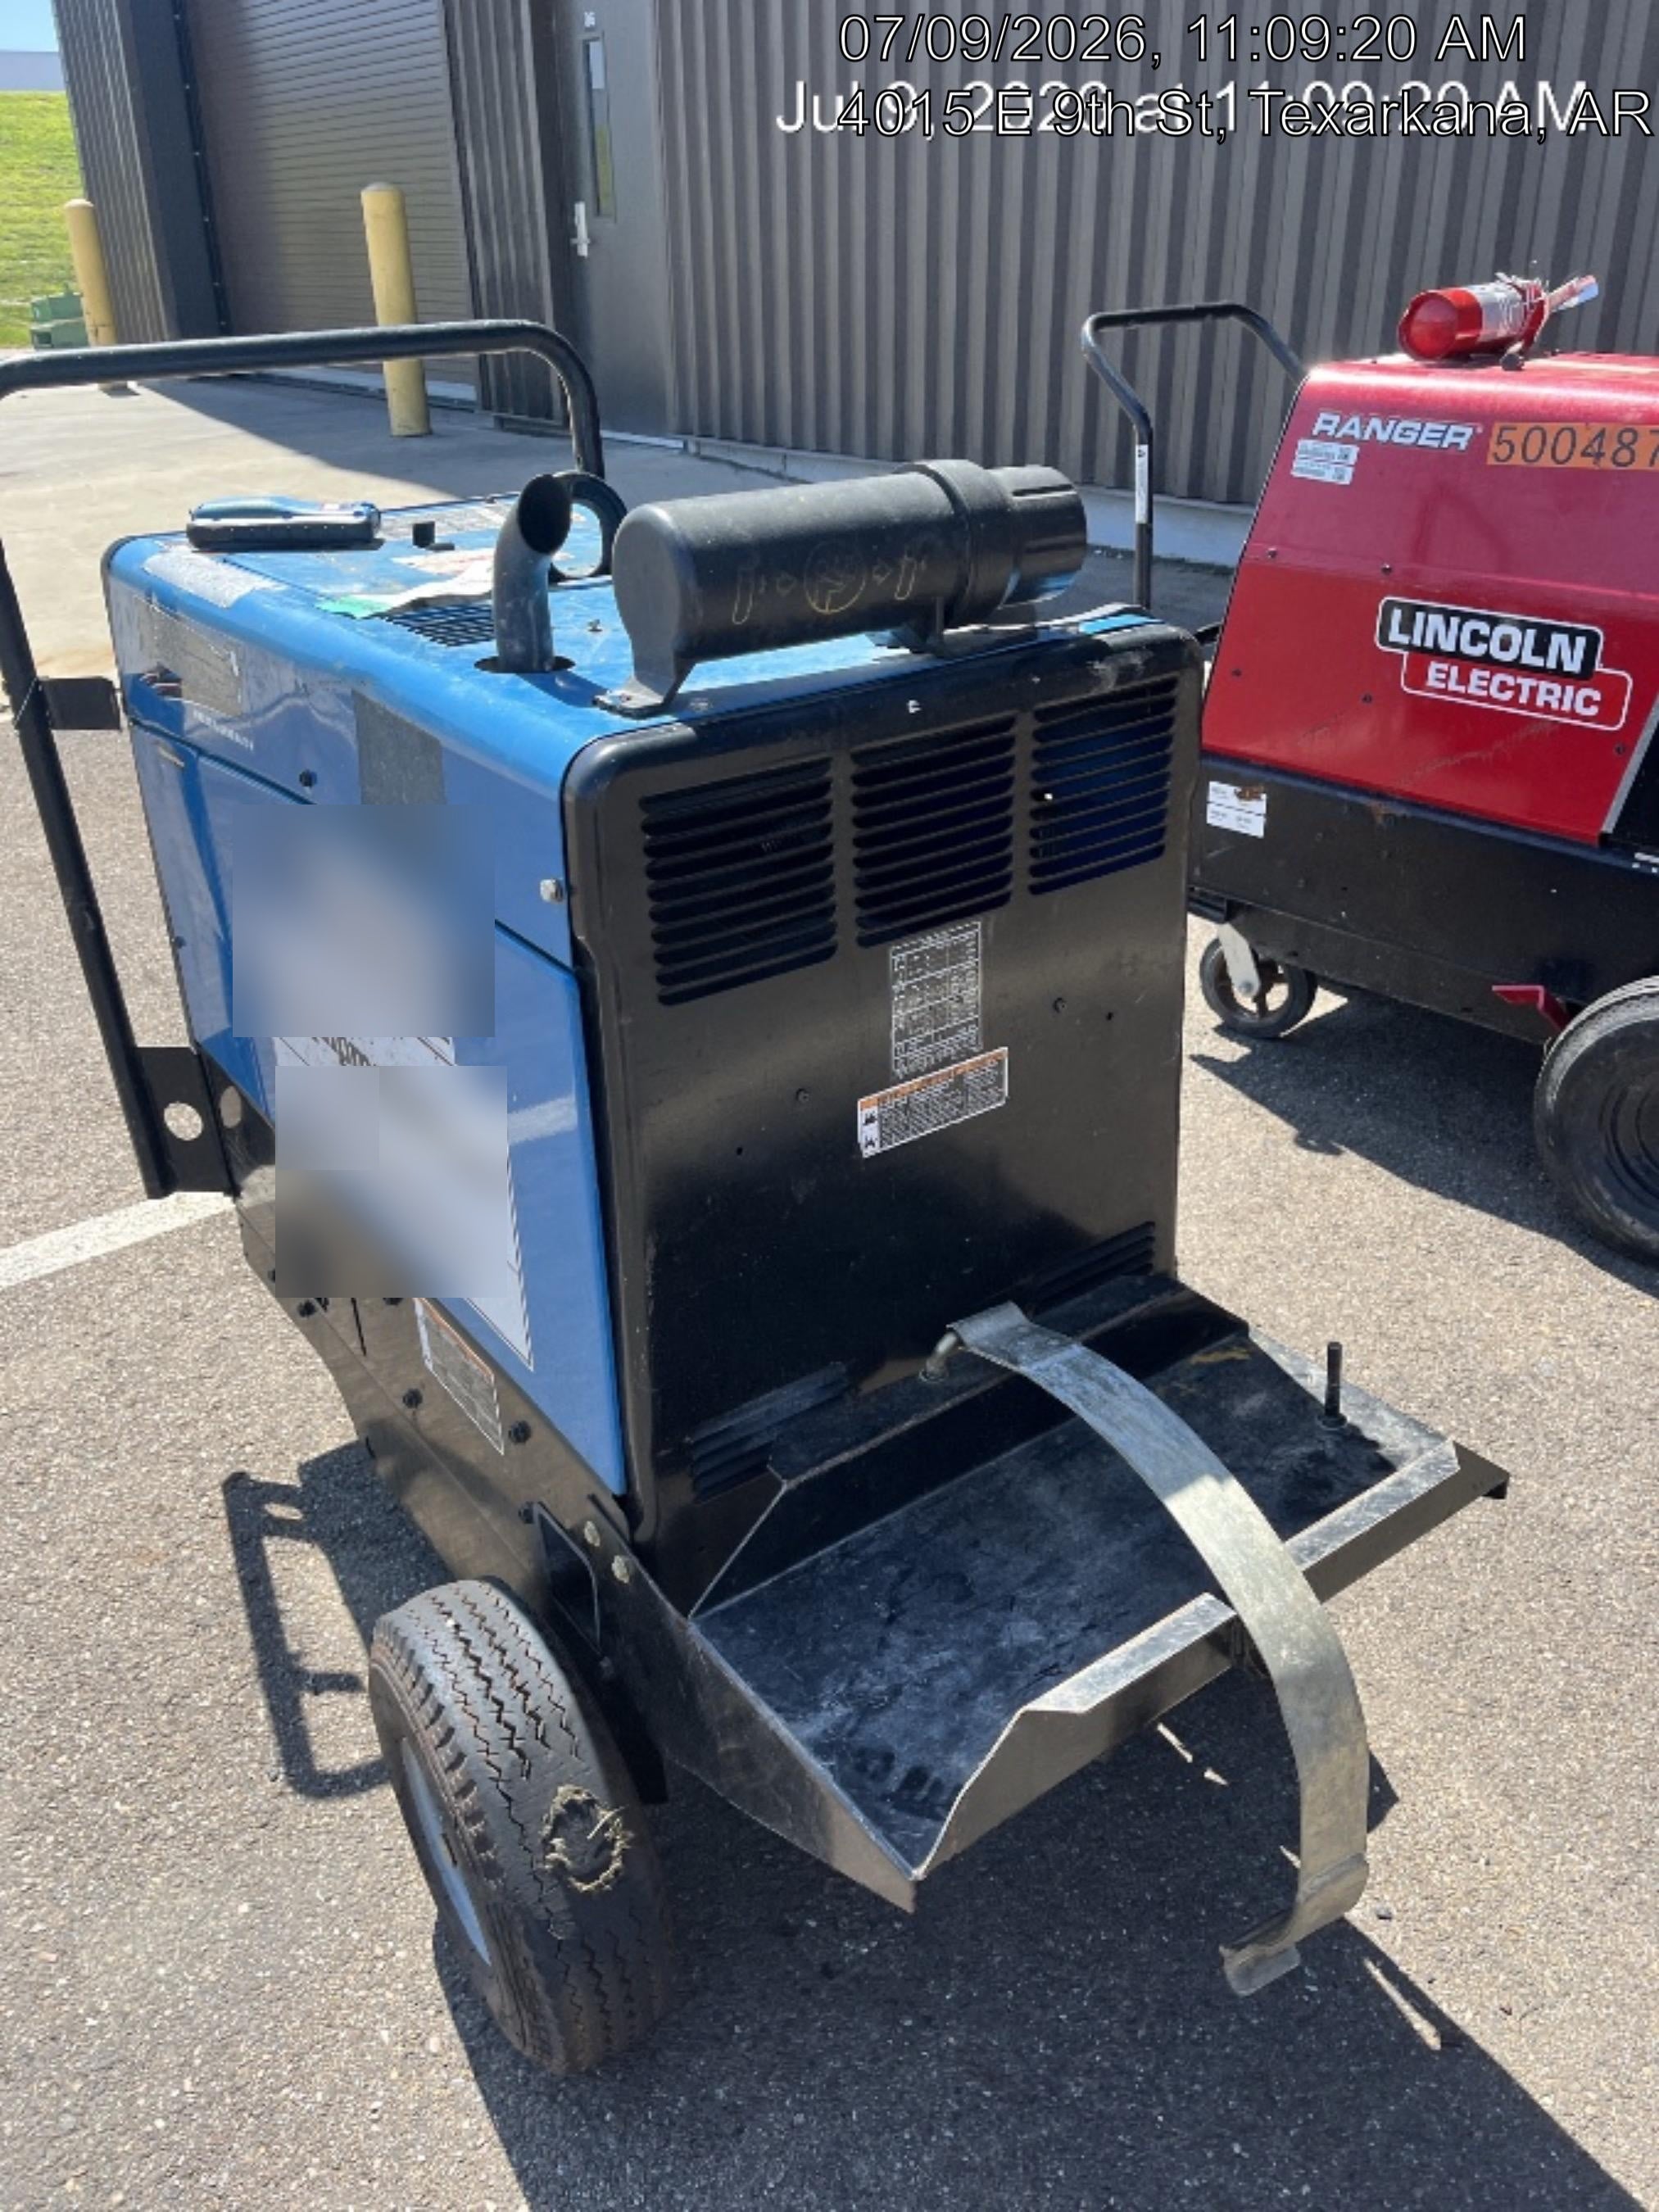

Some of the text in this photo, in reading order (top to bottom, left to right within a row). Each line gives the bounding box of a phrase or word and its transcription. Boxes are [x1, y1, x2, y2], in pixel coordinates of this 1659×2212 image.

[1312, 412, 1474, 451] RANGER
[1389, 607, 1587, 673] LINCOLN
[1426, 660, 1602, 717] ELECTRIC
